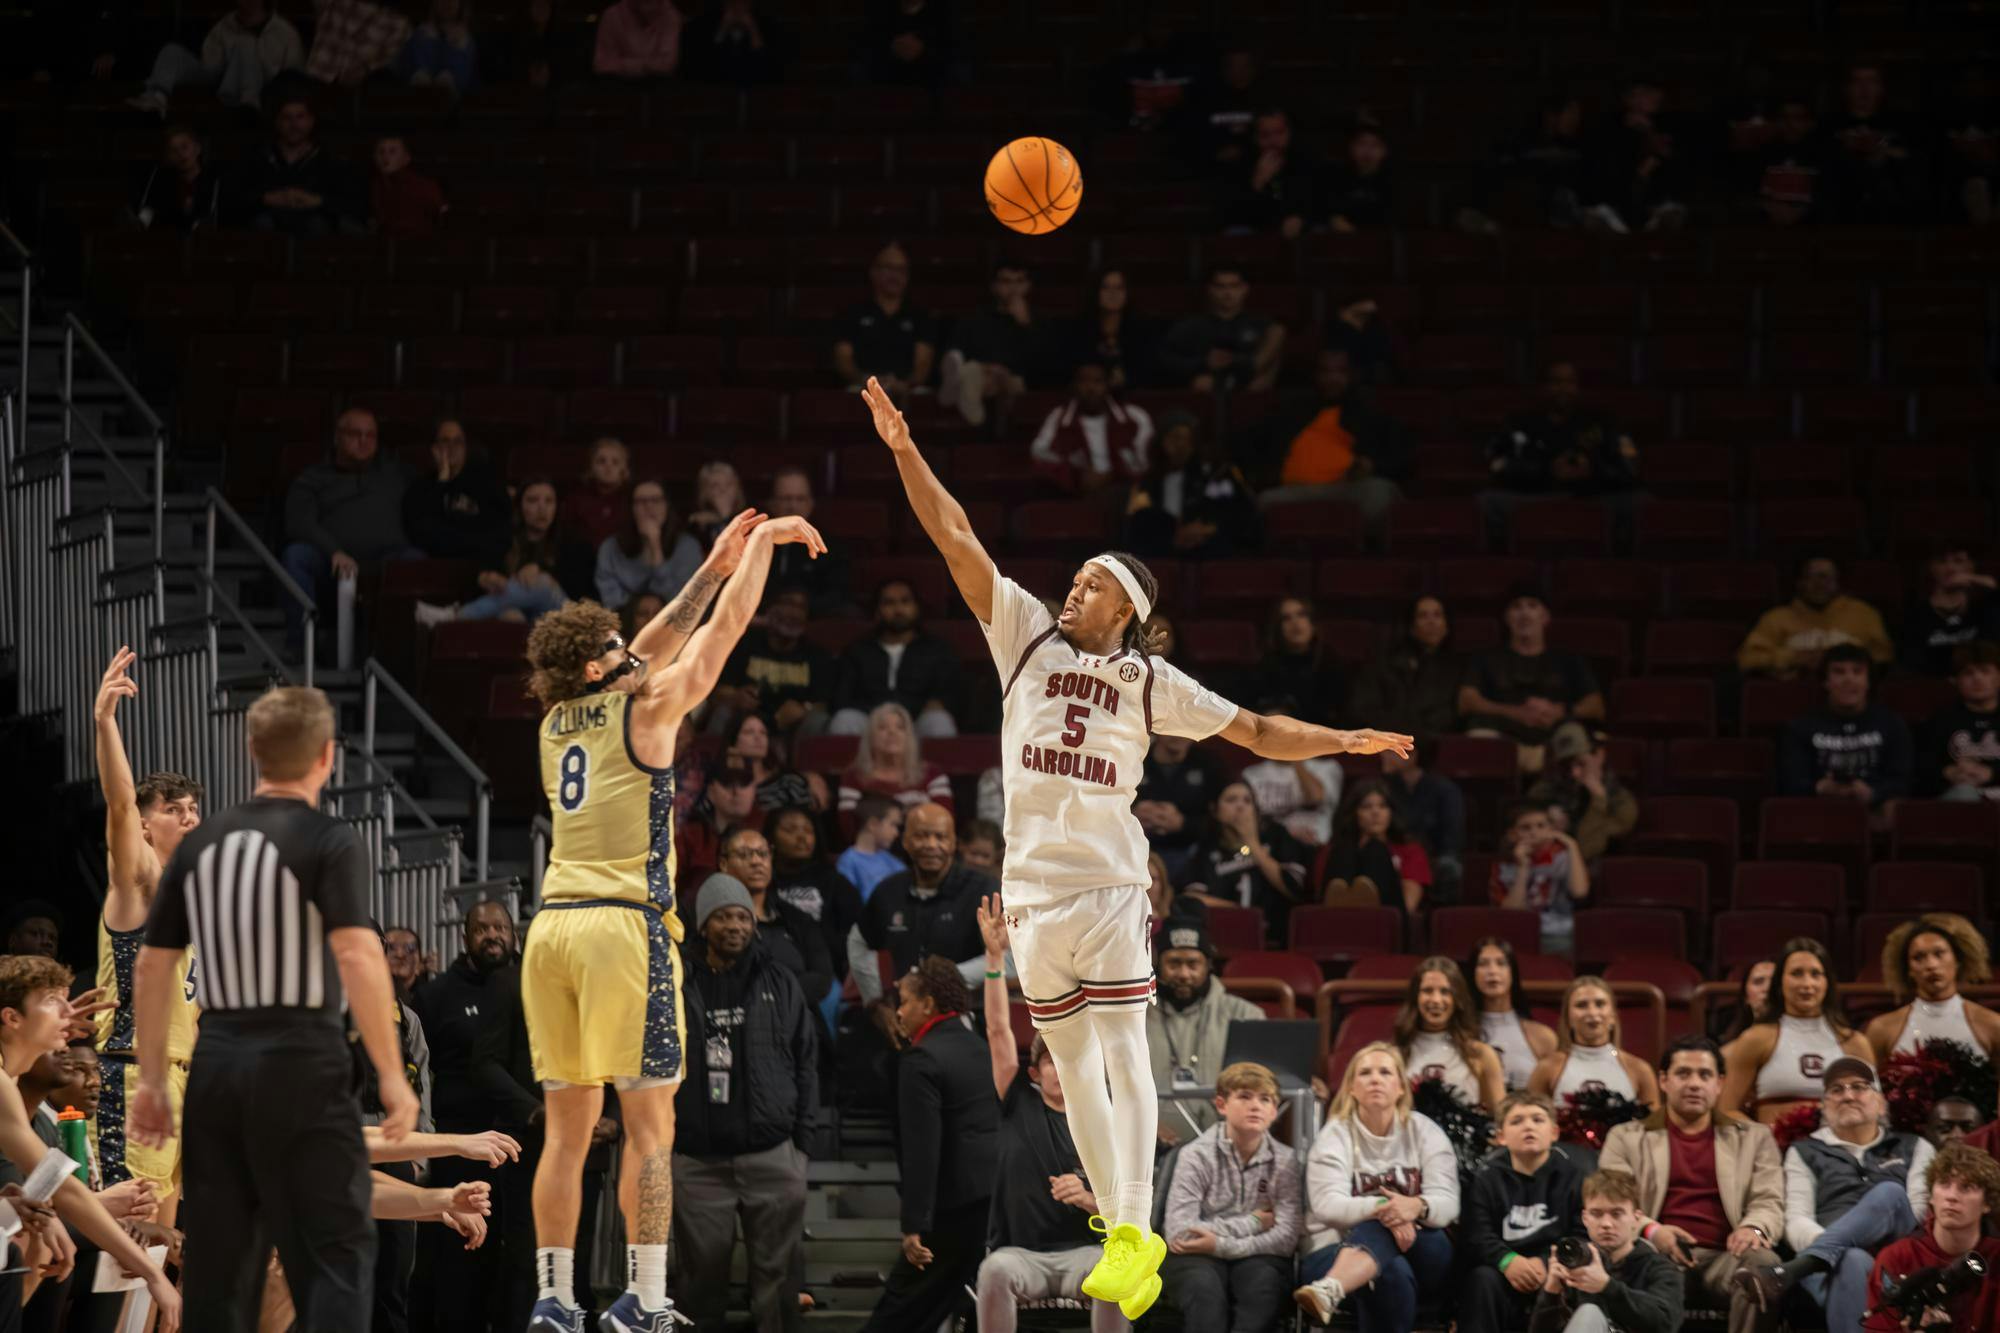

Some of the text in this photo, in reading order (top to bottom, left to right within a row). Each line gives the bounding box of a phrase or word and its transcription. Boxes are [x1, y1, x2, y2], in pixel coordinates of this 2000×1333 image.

[1045, 672, 1120, 716] SOUTH
[1061, 703, 1091, 748] 5
[559, 743, 588, 813] 8
[1021, 743, 1117, 787] CAROLINA
[1510, 1203, 1548, 1227] NIKE
